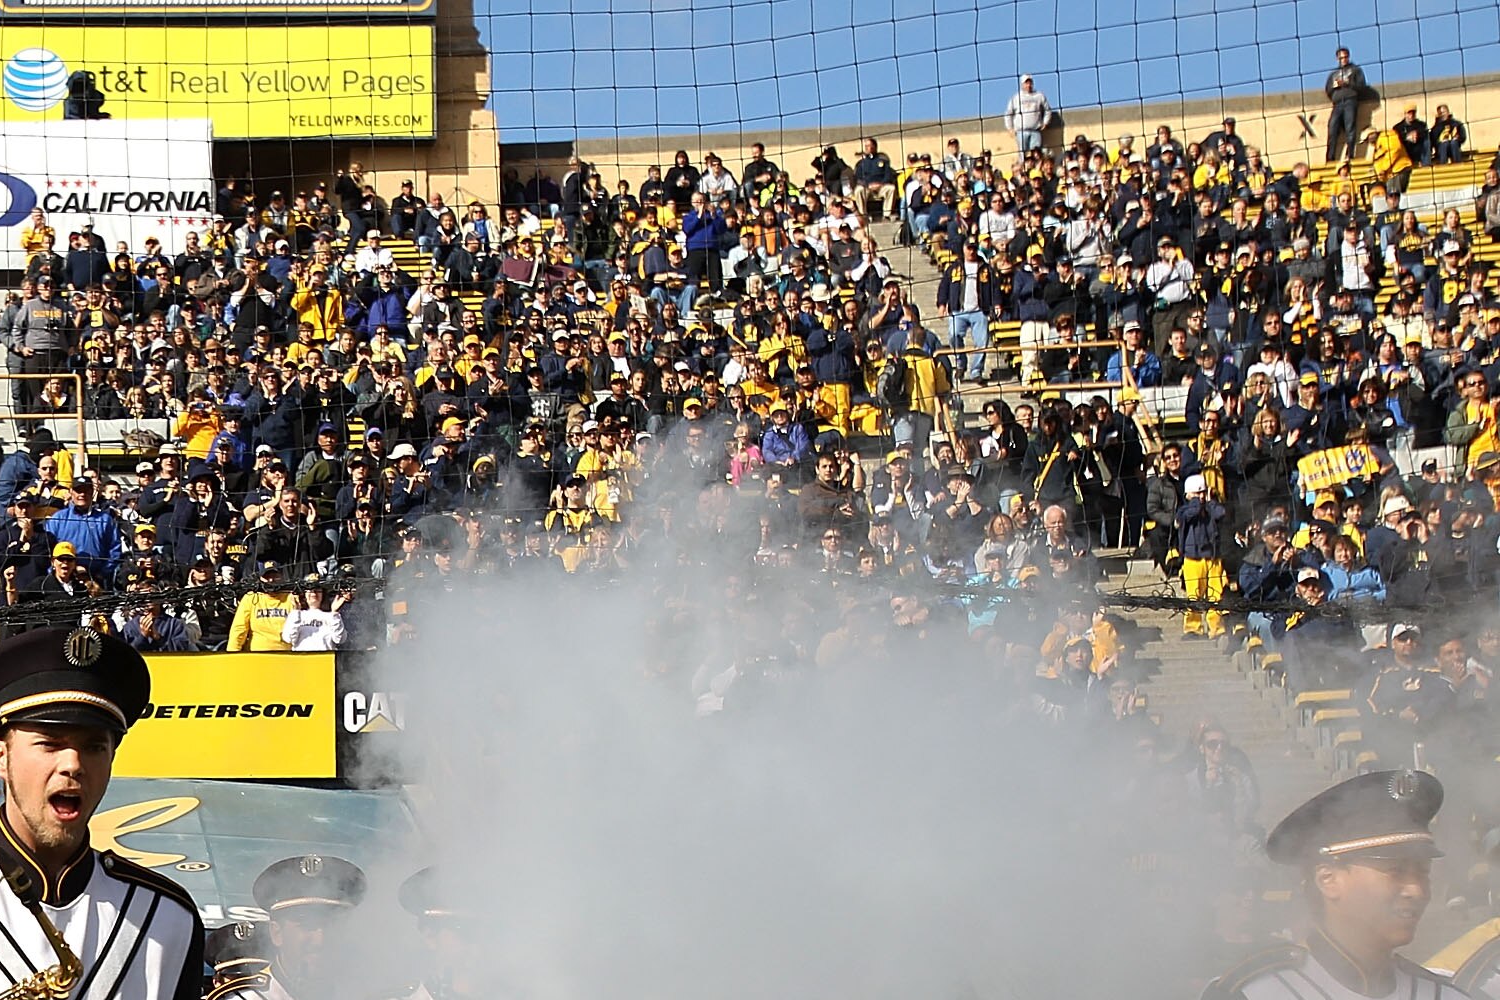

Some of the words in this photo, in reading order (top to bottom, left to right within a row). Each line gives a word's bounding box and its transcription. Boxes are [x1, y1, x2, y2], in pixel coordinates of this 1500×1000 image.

[170, 70, 228, 94] Real
[241, 70, 329, 94] Yellow
[343, 70, 426, 99] Pages
[289, 114, 424, 127] YELLOWPAGES.COM
[43, 191, 211, 214] CALIFORNIA
